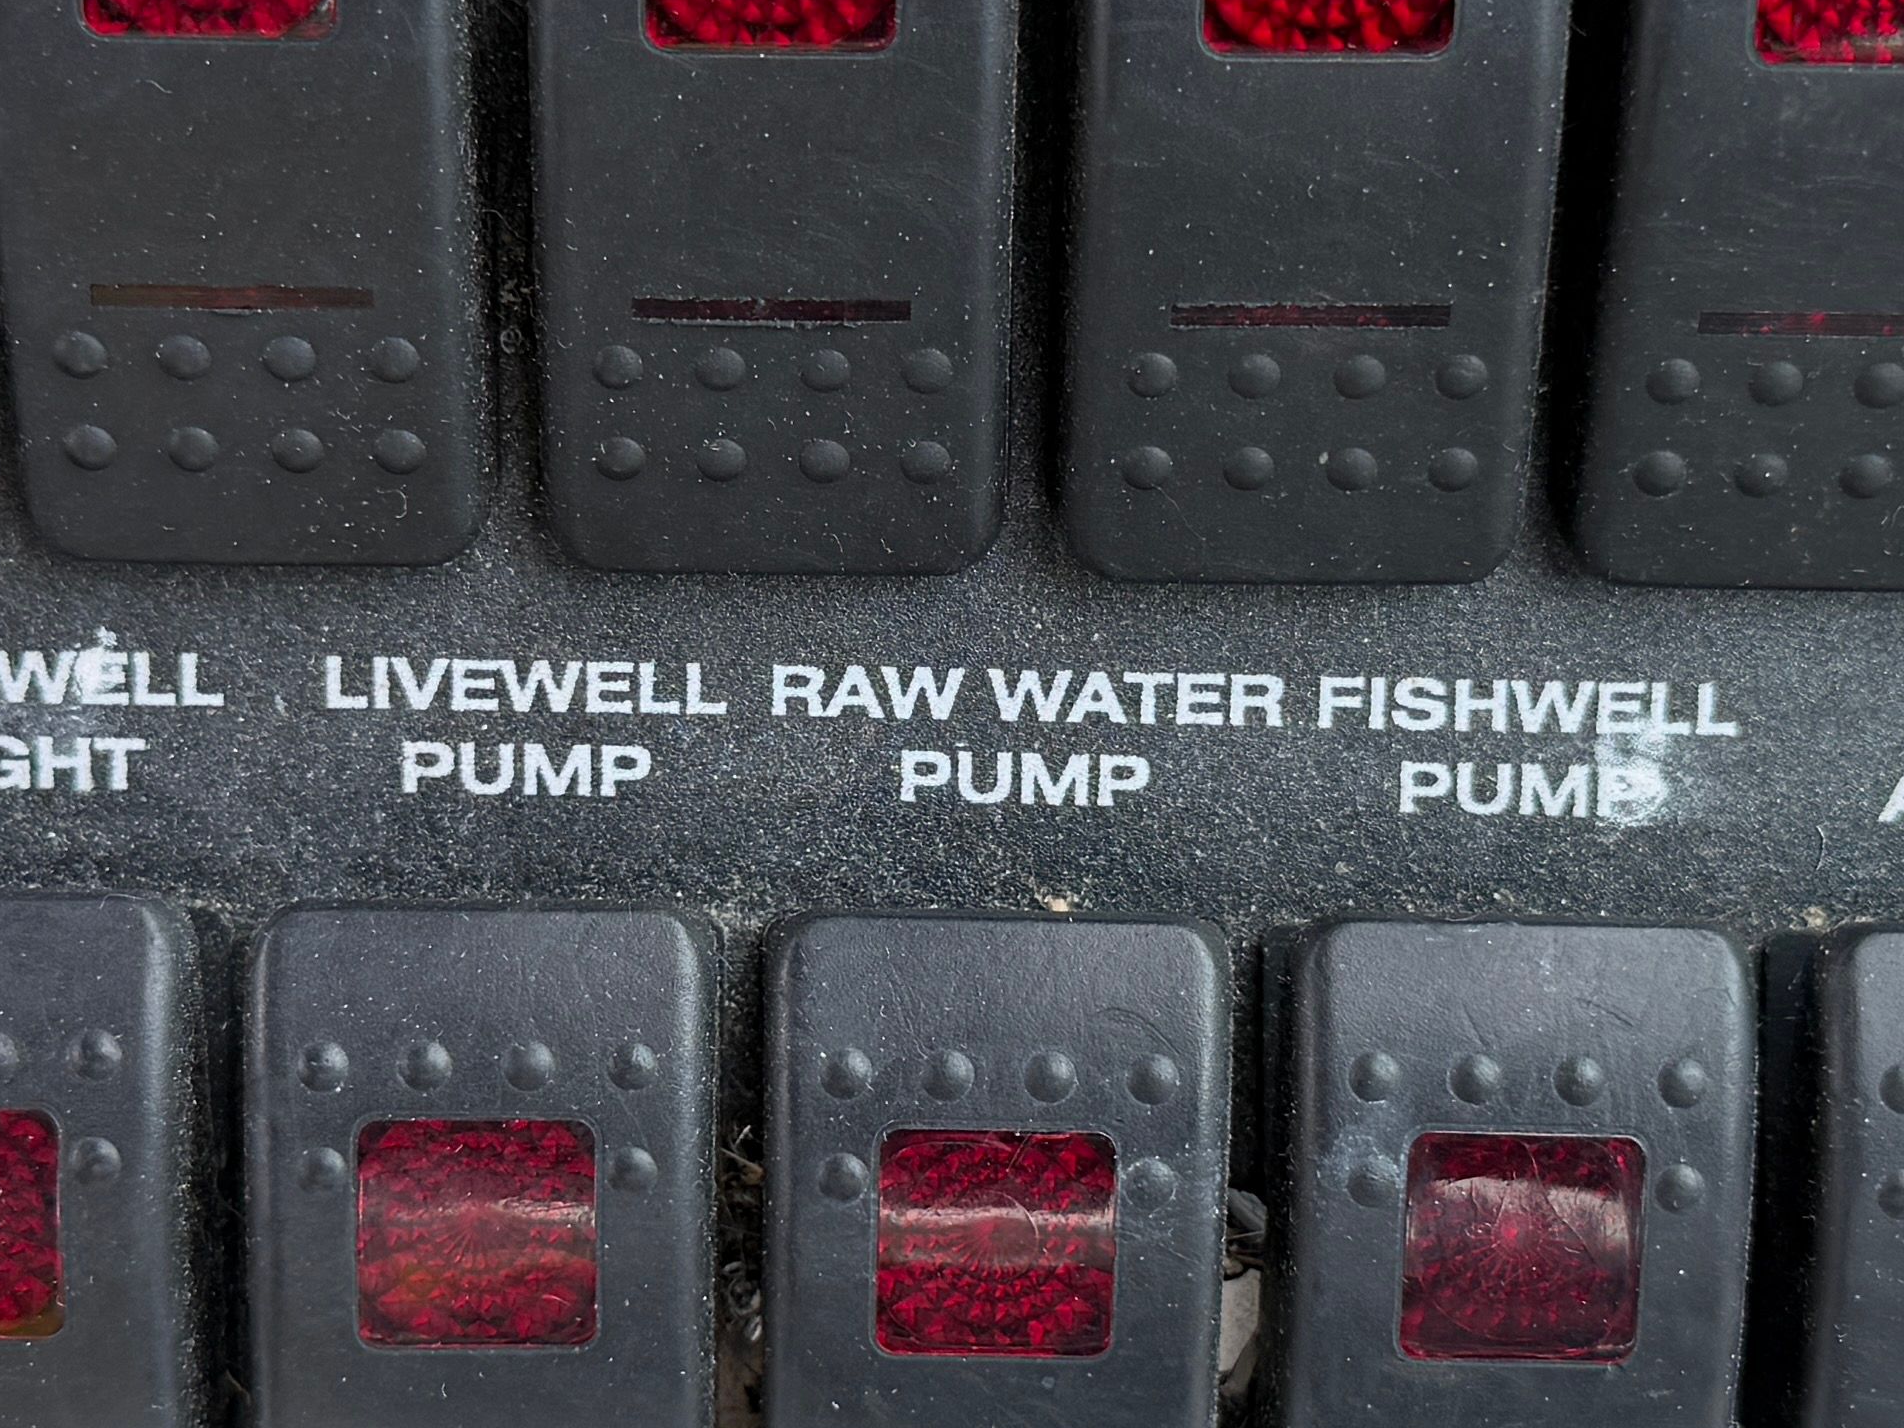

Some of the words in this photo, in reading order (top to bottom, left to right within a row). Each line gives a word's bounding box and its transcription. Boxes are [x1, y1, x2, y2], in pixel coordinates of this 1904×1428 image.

[324, 655, 726, 718] LIVEWELL
[770, 664, 965, 722] RAW
[990, 671, 1283, 730] WATER
[1316, 676, 1739, 738] FISHWELL
[402, 741, 652, 798] PUMP
[899, 746, 1149, 807] PUMP
[1397, 761, 1667, 820] PUMP
